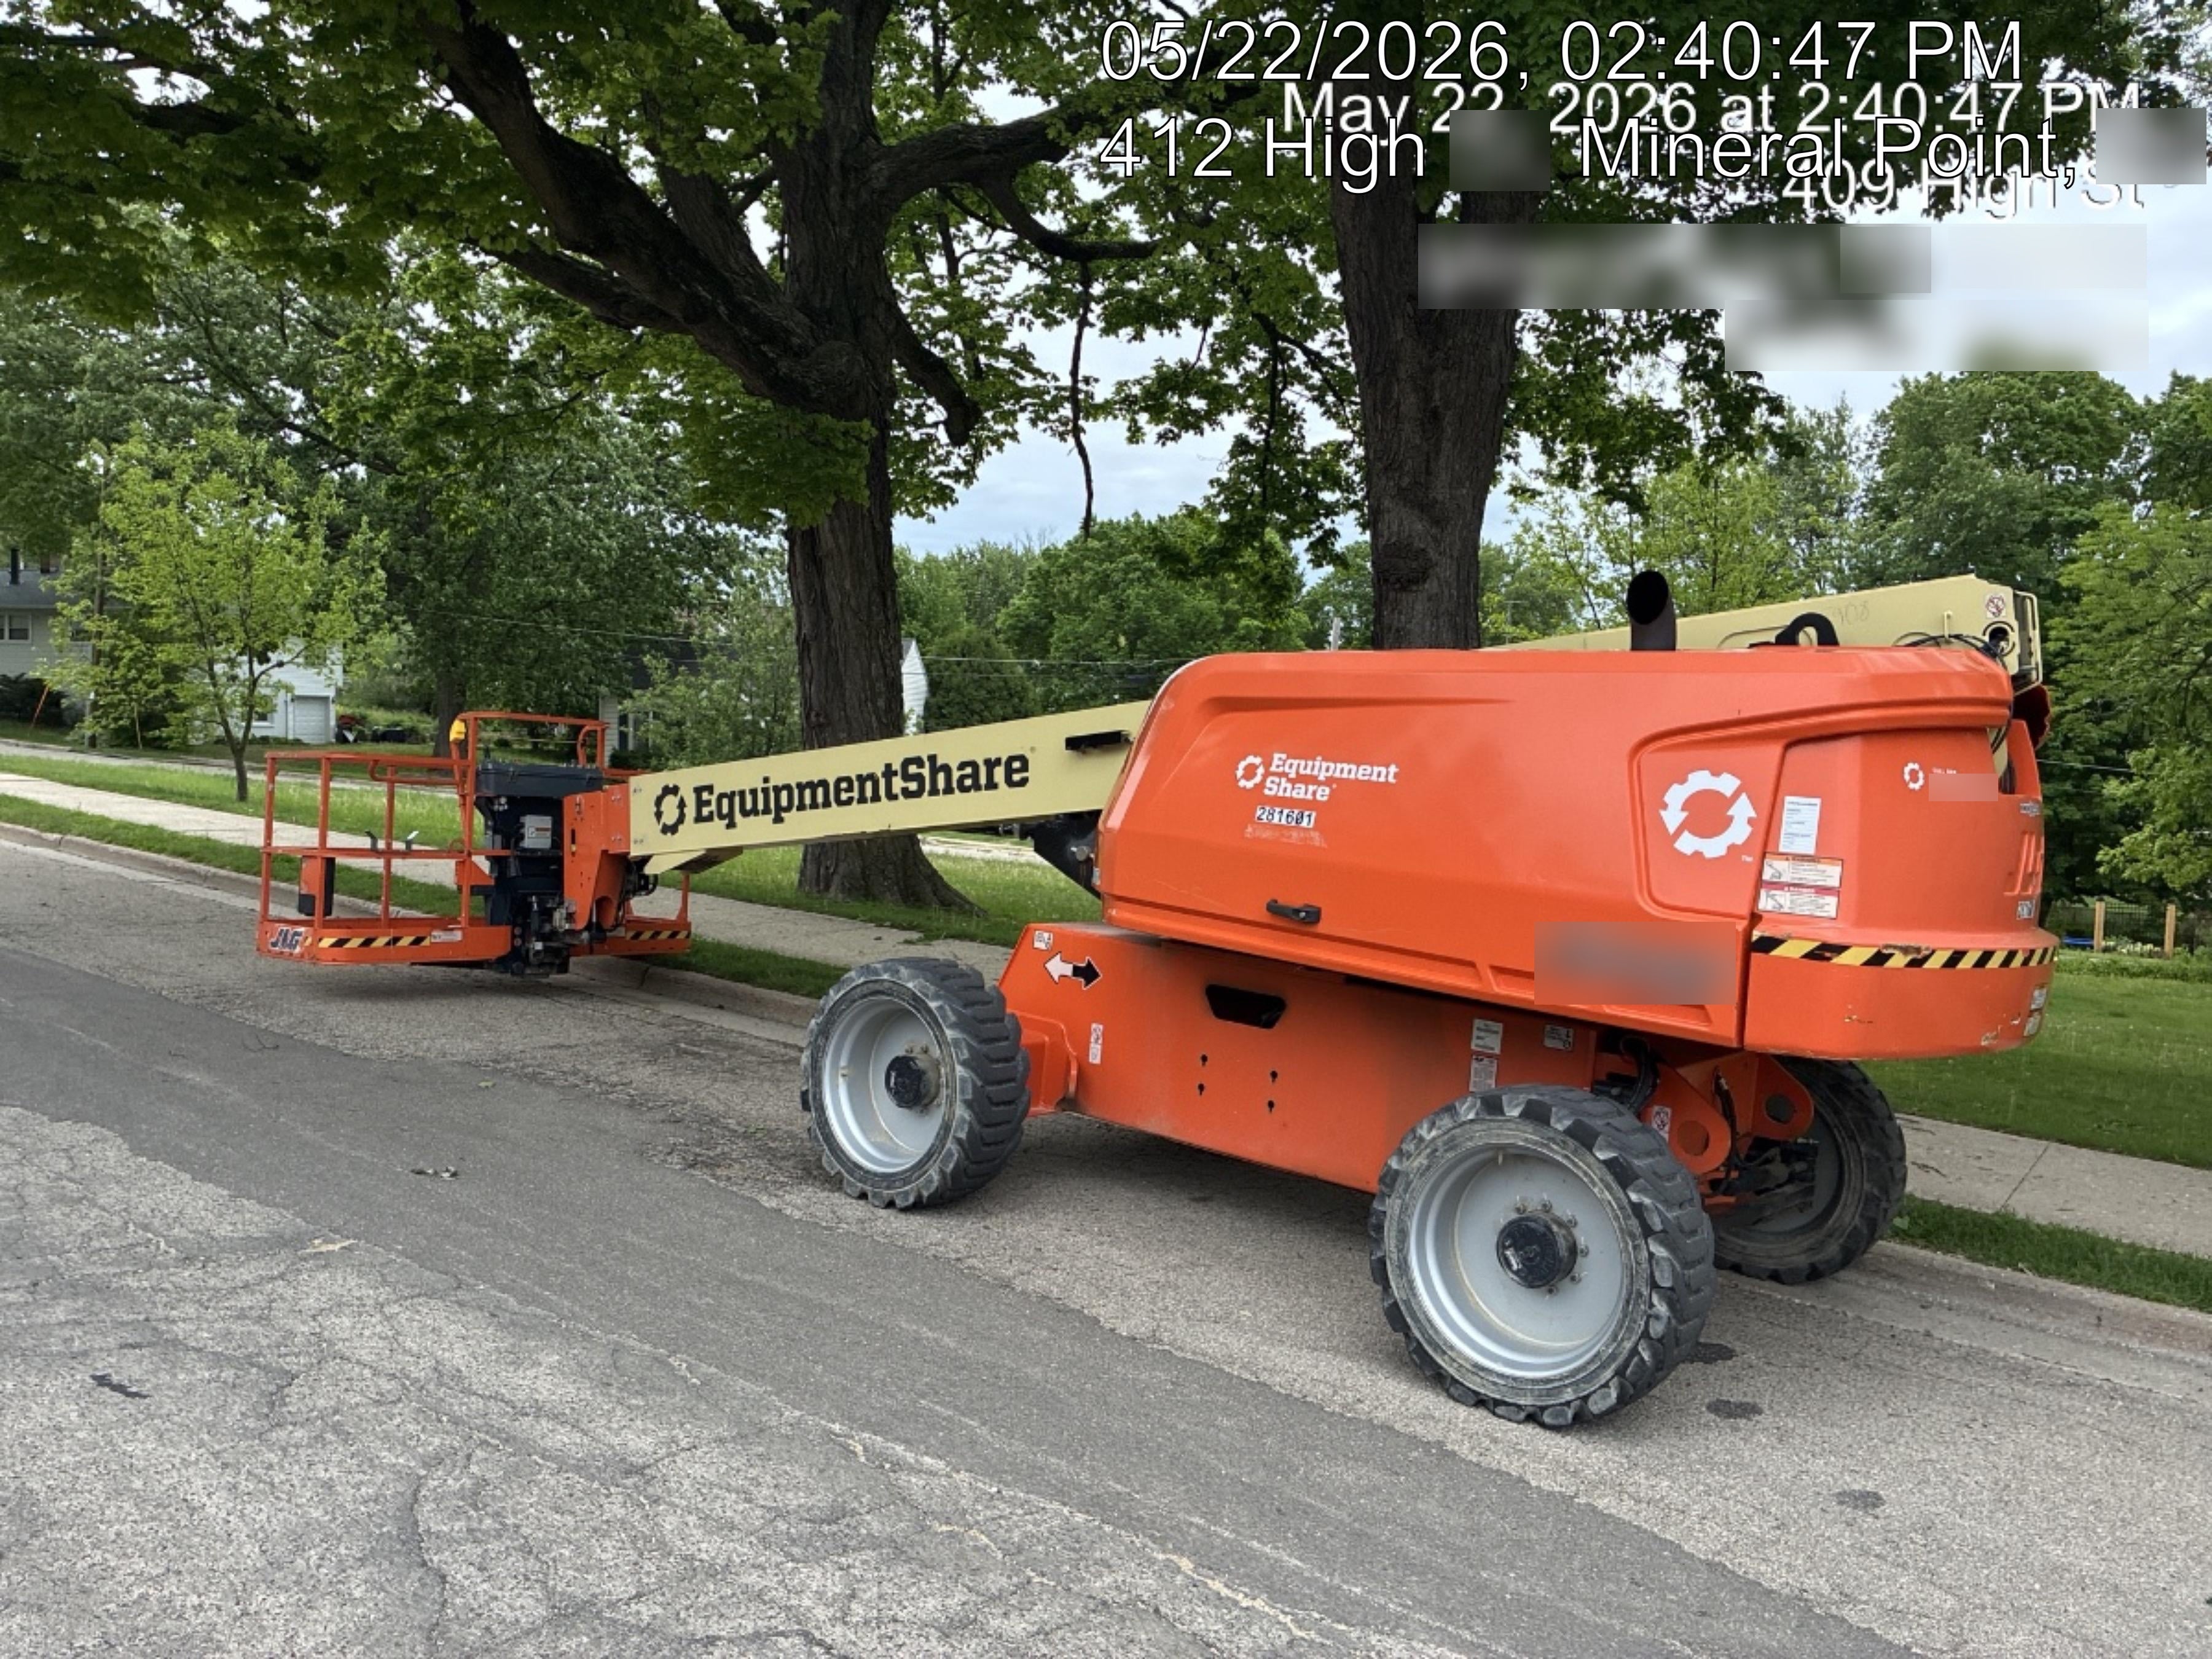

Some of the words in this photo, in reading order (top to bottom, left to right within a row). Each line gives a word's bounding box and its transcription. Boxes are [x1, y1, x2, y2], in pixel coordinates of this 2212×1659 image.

[1269, 752, 1400, 783] Equipment
[693, 753, 1030, 830] EquipmentShare
[1263, 776, 1330, 801] Share
[1257, 806, 1314, 826] 281601
